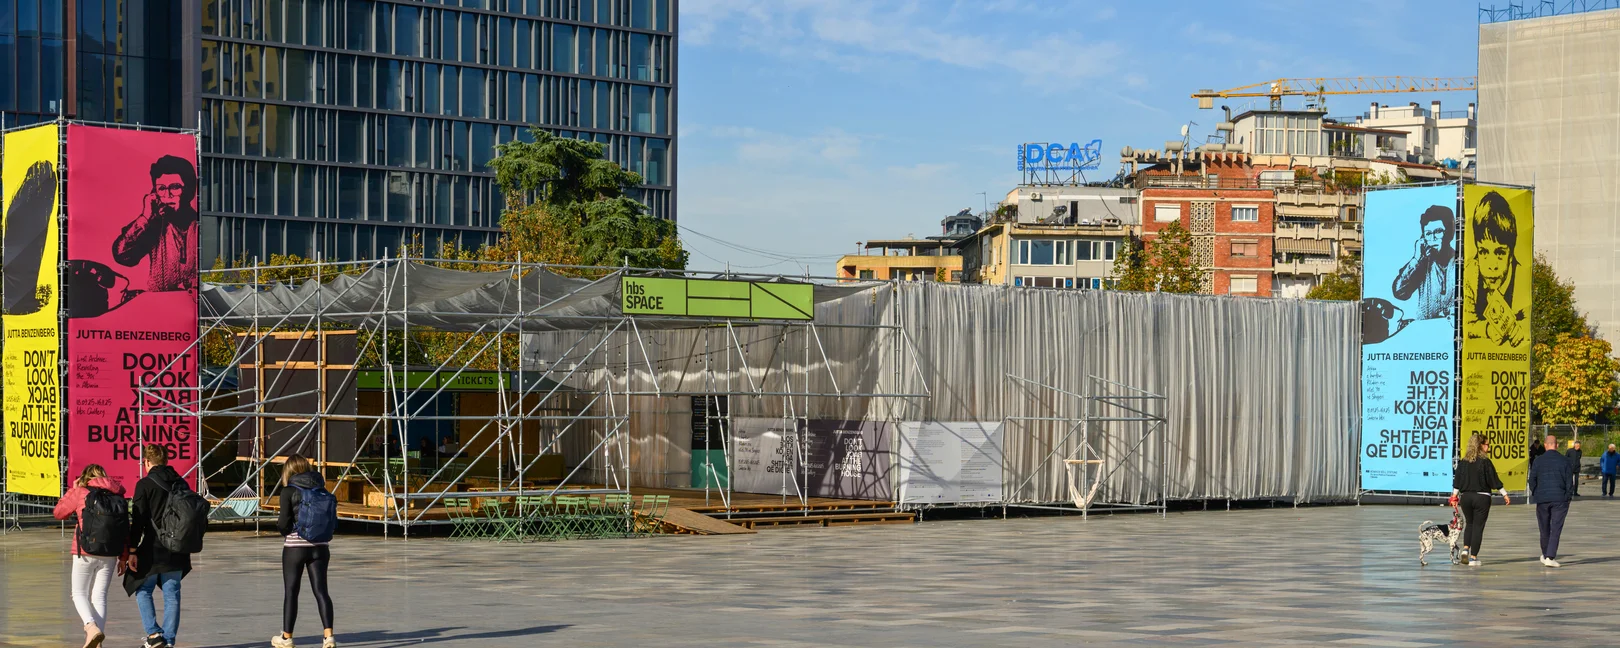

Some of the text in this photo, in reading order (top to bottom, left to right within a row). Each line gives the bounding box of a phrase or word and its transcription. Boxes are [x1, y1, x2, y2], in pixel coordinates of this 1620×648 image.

[1026, 142, 1084, 163] DCA
[626, 281, 645, 295] hbs
[626, 295, 664, 310] SPACE
[7, 328, 55, 338] JUTTA BENZENBERG
[76, 330, 191, 341] JUTTA BENZENBERG
[24, 350, 56, 367] DON'T
[123, 353, 191, 370] DON'T
[1367, 352, 1449, 361] JUTTA BENZENBERG
[1467, 352, 1527, 361] JUTTA BENZENBERG
[27, 368, 55, 385] LOOK
[130, 371, 191, 388] LOOK
[380, 376, 403, 384] SOP
[456, 376, 494, 385] TICKETS
[1410, 370, 1449, 385] MOS
[1491, 371, 1527, 386] DON'T
[1495, 386, 1526, 400] LOOK
[21, 404, 34, 421] AT
[35, 404, 56, 422] THE
[1394, 397, 1448, 415] KOKËN
[115, 407, 190, 424] AT THE
[1413, 415, 1448, 430] NGA
[1486, 416, 1501, 430] AT
[1504, 416, 1526, 430] THE
[10, 421, 56, 440] BURNING
[88, 425, 191, 442] BURNING
[1380, 427, 1448, 444] SHTËPIA
[20, 440, 55, 458] HOUSE
[113, 443, 190, 460] HOSE
[1366, 440, 1448, 460] QË DIGJET
